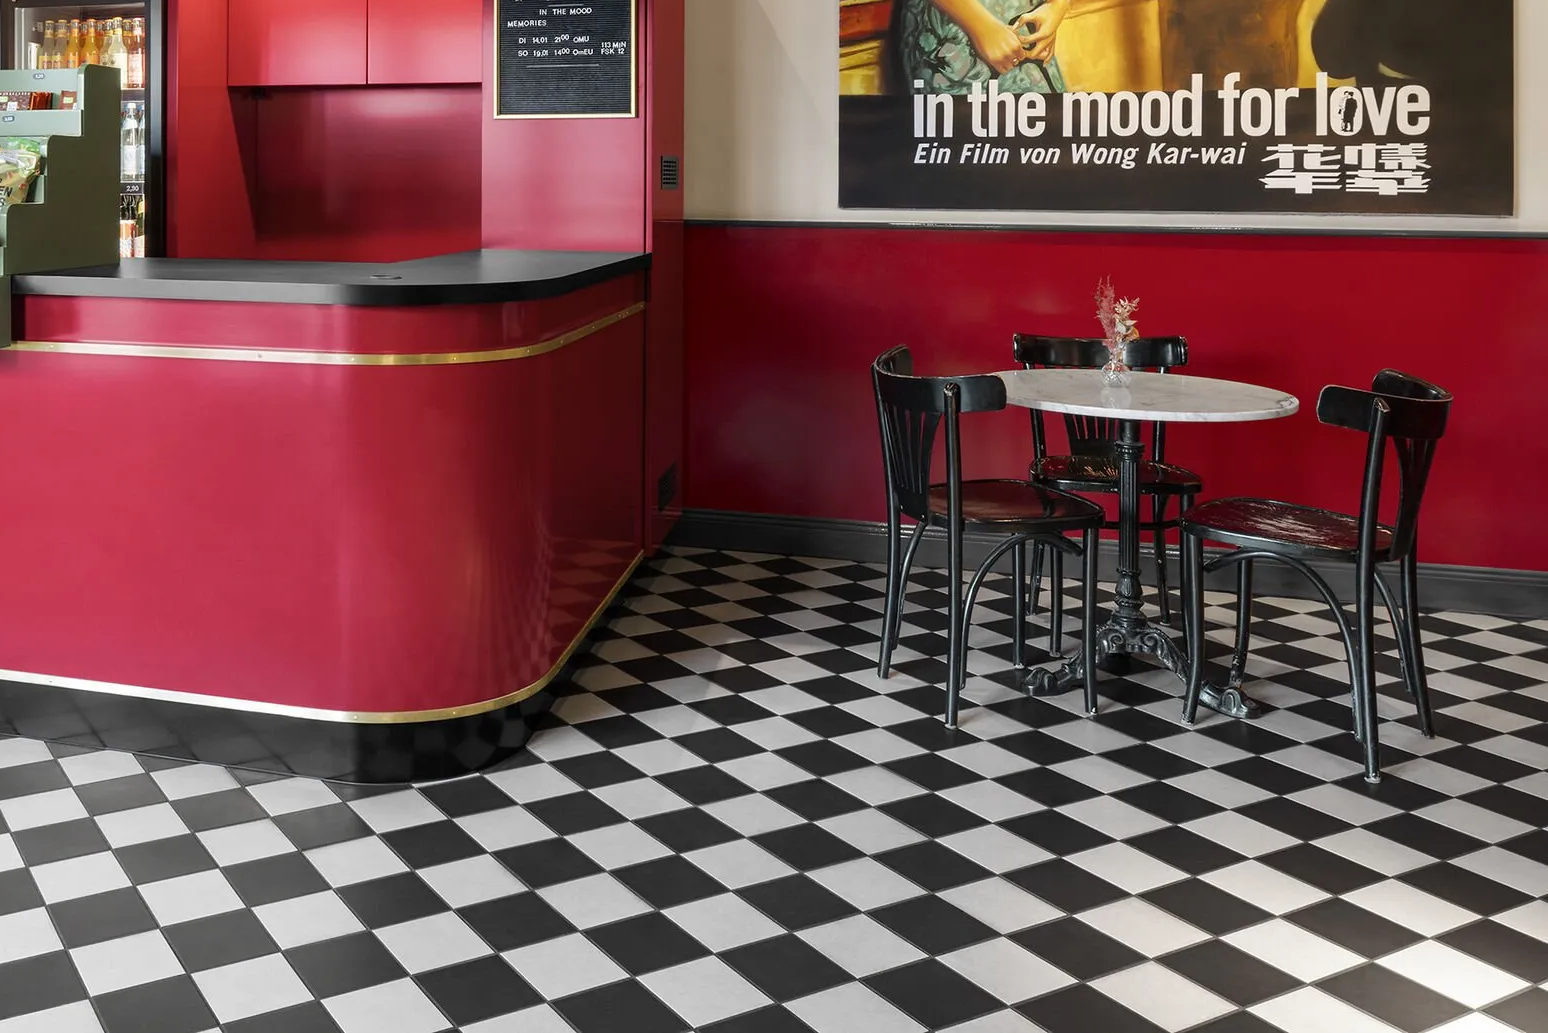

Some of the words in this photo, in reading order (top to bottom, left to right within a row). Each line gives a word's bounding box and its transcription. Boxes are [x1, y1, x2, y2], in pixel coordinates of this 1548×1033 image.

[913, 79, 953, 138] in
[967, 79, 1046, 138] the
[1062, 73, 1203, 137] mood
[1218, 72, 1299, 137] for
[1315, 71, 1431, 137] love
[913, 143, 951, 165] Ein
[960, 143, 1010, 165] Film
[1020, 147, 1061, 165] von
[1071, 143, 1139, 170] Wong
[1147, 141, 1247, 166] Kar-wai
